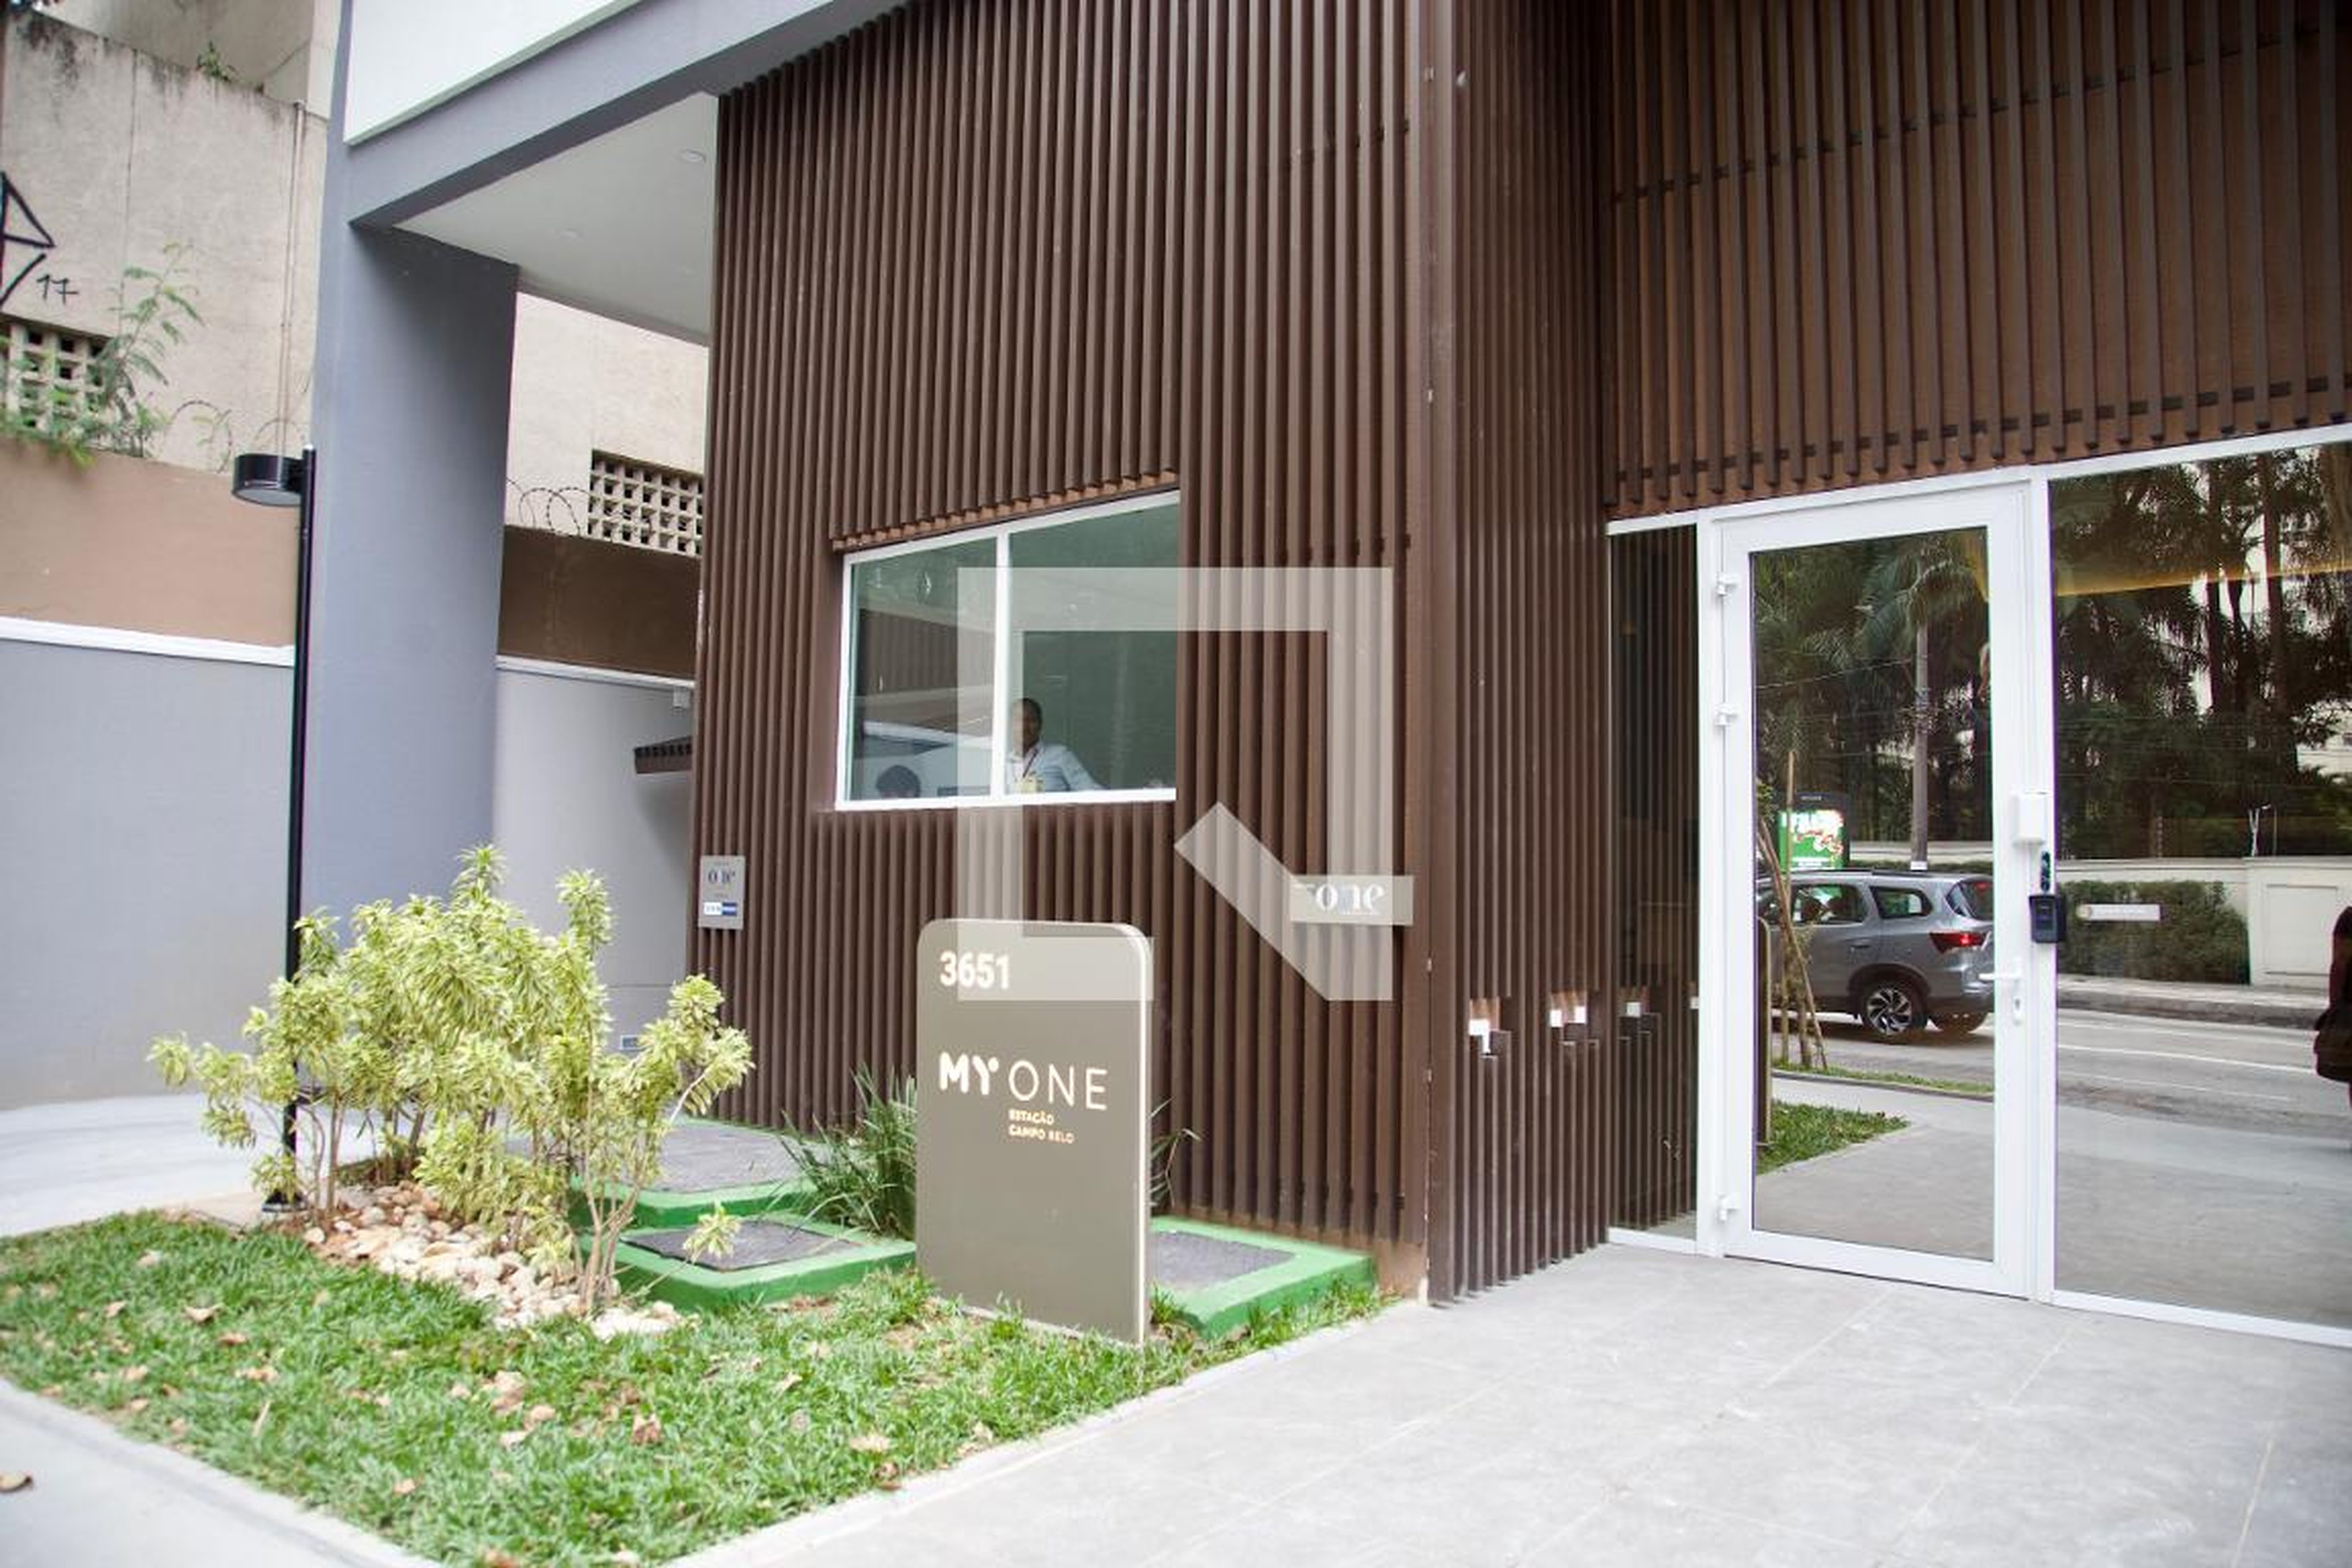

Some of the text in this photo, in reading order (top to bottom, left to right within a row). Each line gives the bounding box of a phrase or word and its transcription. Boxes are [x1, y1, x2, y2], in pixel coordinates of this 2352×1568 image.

[939, 949, 1011, 990] 3651
[1008, 1060, 1109, 1111] ONE
[1008, 1123, 1075, 1144] CAMPO BELO
